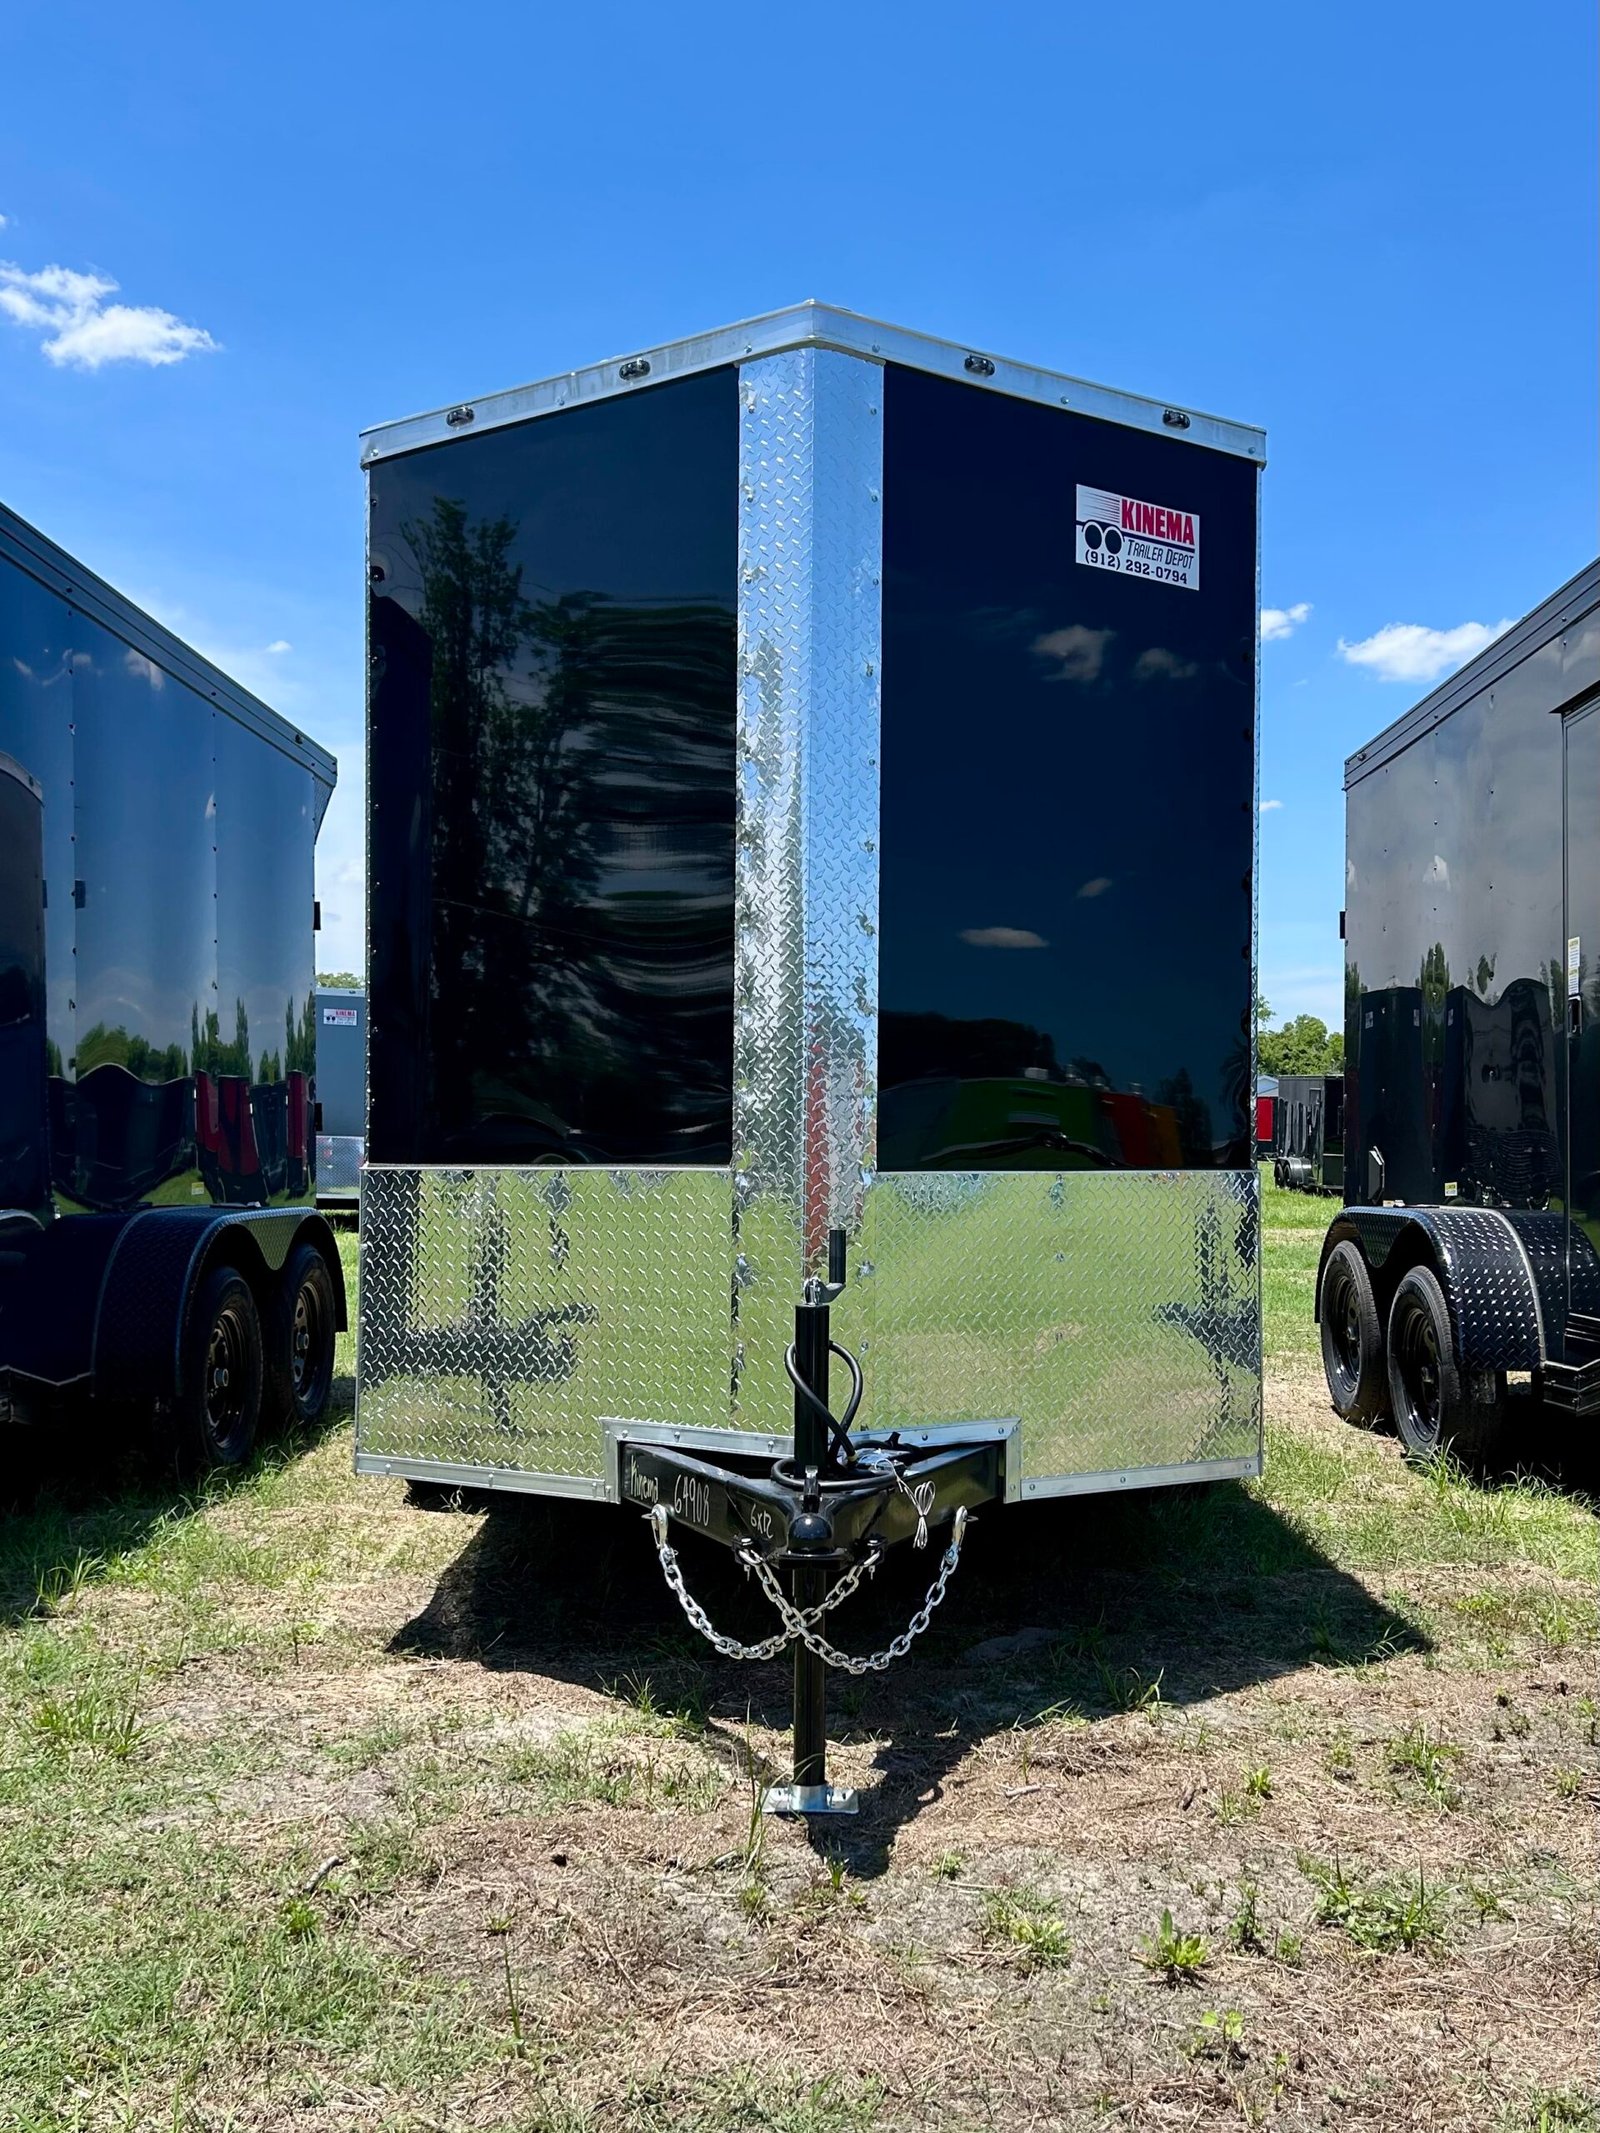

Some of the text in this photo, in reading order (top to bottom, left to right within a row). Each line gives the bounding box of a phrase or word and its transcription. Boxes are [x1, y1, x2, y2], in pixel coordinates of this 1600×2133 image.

[1121, 499, 1195, 546] KINEMA
[1085, 549, 1188, 585] (912) 292-0794
[1127, 539, 1195, 570] TRAILER DEPOT
[674, 1474, 710, 1527] 64908
